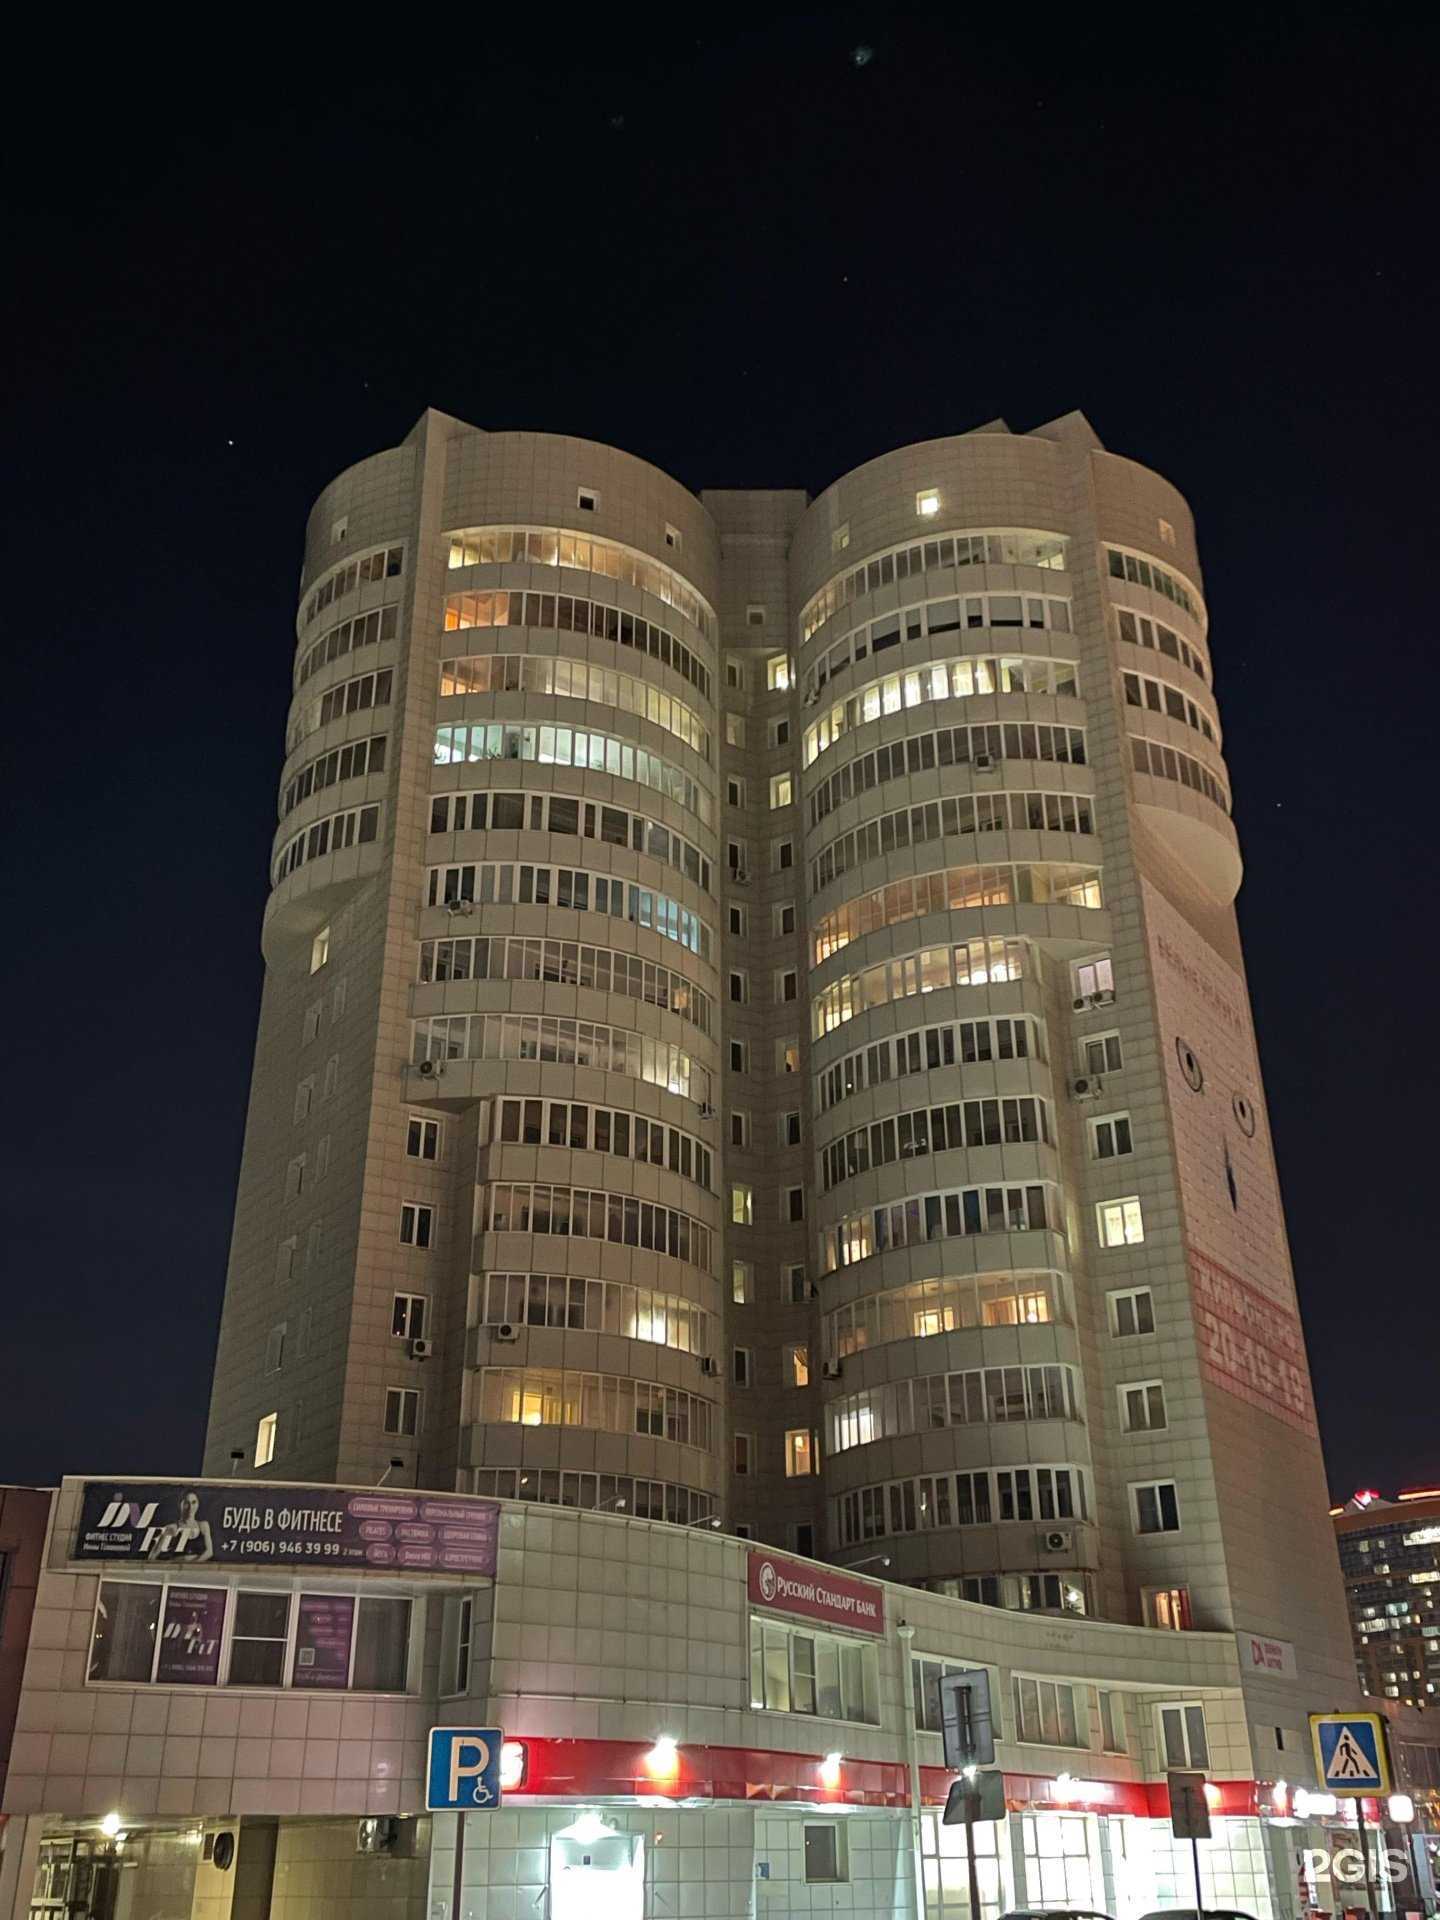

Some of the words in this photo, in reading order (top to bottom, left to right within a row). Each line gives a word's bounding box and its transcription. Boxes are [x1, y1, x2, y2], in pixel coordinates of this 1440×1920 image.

[222, 1507, 260, 1533] БУДЬ
[264, 1508, 275, 1530] В
[277, 1508, 343, 1533] ФИТНЕСЕ
[221, 1540, 238, 1552] +7
[240, 1540, 276, 1555] (906)
[279, 1541, 303, 1554] 946
[305, 1542, 321, 1555] 39
[323, 1543, 340, 1556] 99
[448, 1736, 490, 1801] P
